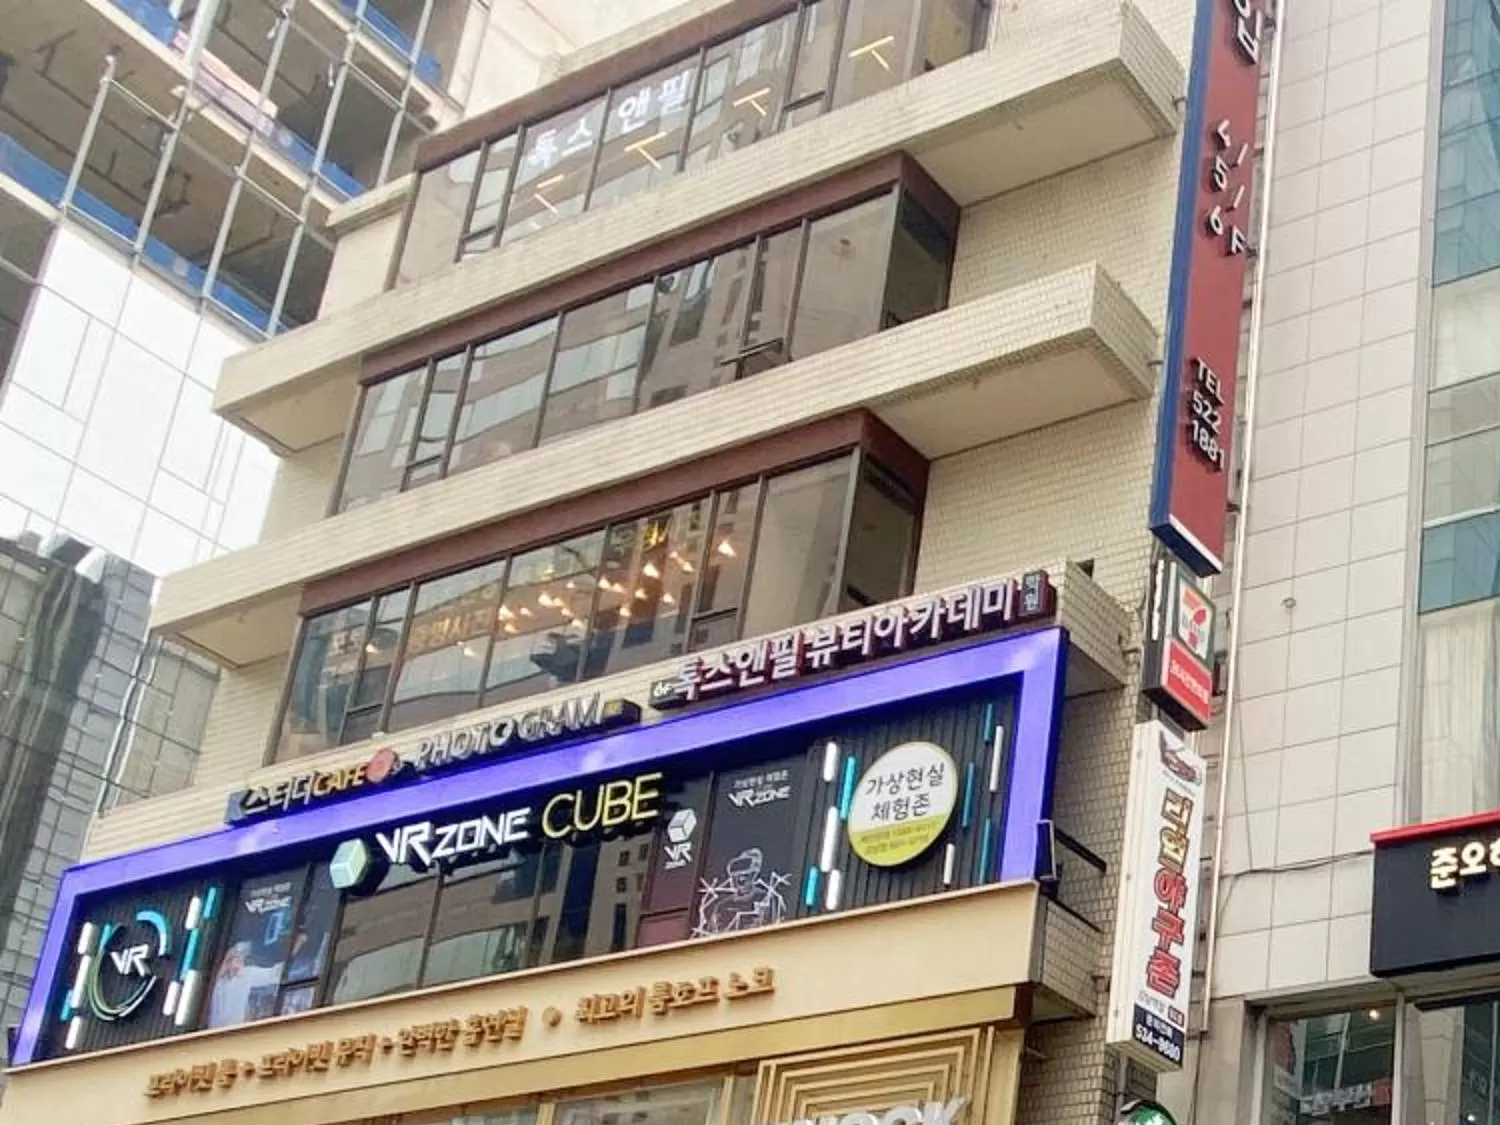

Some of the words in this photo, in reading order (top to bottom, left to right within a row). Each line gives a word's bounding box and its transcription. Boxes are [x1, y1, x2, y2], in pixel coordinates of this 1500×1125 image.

[1197, 356, 1226, 405] TEL
[1192, 390, 1222, 434] 522
[866, 761, 946, 797] 가상현실
[540, 772, 663, 840] CUBE
[871, 793, 931, 821] 체험존
